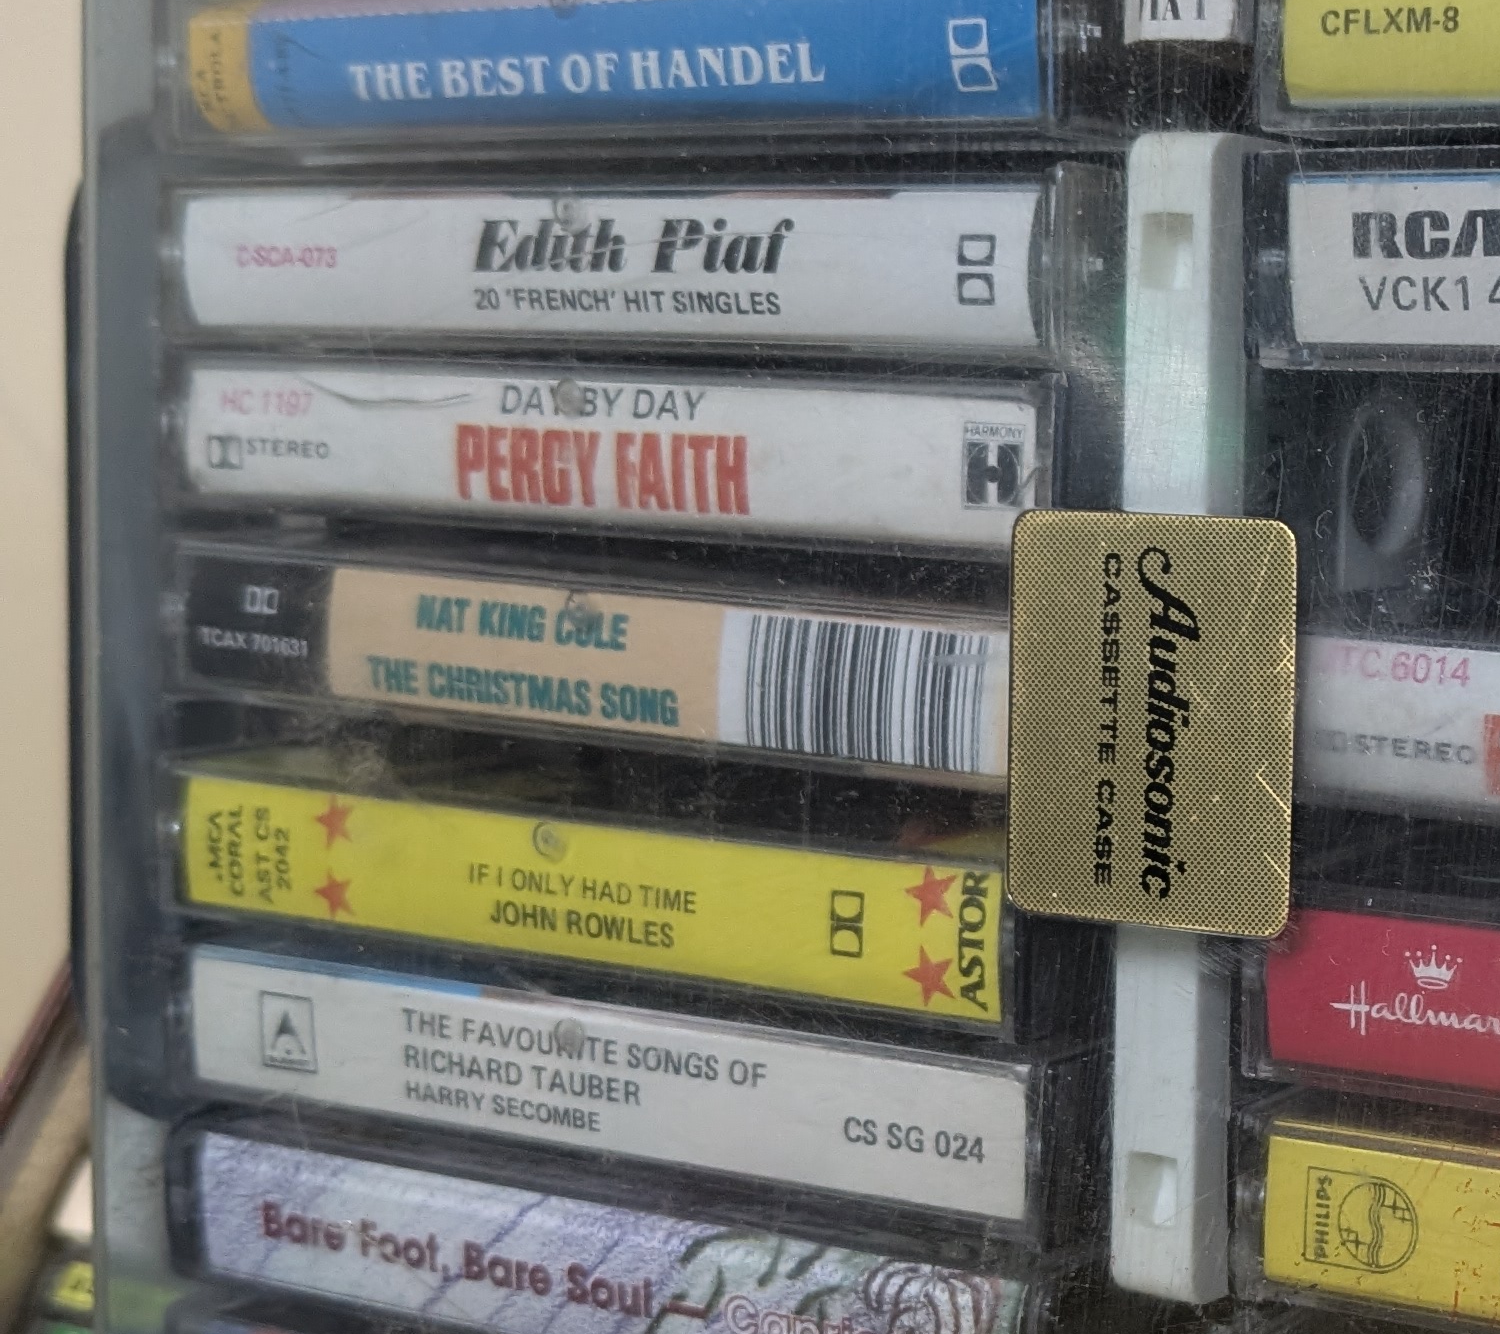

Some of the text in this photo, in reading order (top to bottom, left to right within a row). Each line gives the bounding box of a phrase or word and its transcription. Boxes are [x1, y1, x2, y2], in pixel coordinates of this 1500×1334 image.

[1320, 5, 1460, 38] CFLXM-8
[350, 41, 826, 101] THE BEST OF HANDEL
[474, 217, 795, 274] Edith Piaf
[474, 288, 781, 316] 20 'FRENCH' HIT SINGLES
[1359, 277, 1470, 312] VCK1
[579, 389, 706, 421] BY DAY
[964, 423, 1025, 440] HARMONY
[245, 439, 330, 460] STEREO
[456, 424, 751, 516] PERCY FAITH
[417, 594, 545, 643] NAT KING
[368, 656, 679, 728] THE CHRISTMAS SONG
[1391, 651, 1470, 687] 6014
[1092, 552, 1123, 887] CASSETTE CASE
[1137, 545, 1201, 900] Audiosonic
[1356, 733, 1475, 765] STEREO
[226, 805, 244, 896] CORAL
[277, 827, 291, 892] 2042
[469, 863, 697, 915] IF ONLY HAD TIME
[489, 900, 675, 949] JOHN ROWLES
[958, 870, 990, 1012] ASTOR
[402, 1008, 767, 1088] THE SONGS OF
[404, 1045, 640, 1107] RICHARD TAUBER
[406, 1081, 601, 1132] HARRY SECOMBE
[843, 1116, 985, 1162] CS SG 024
[1313, 1174, 1332, 1262] PHILIPS
[261, 1200, 653, 1318] Bare Bare Soul
